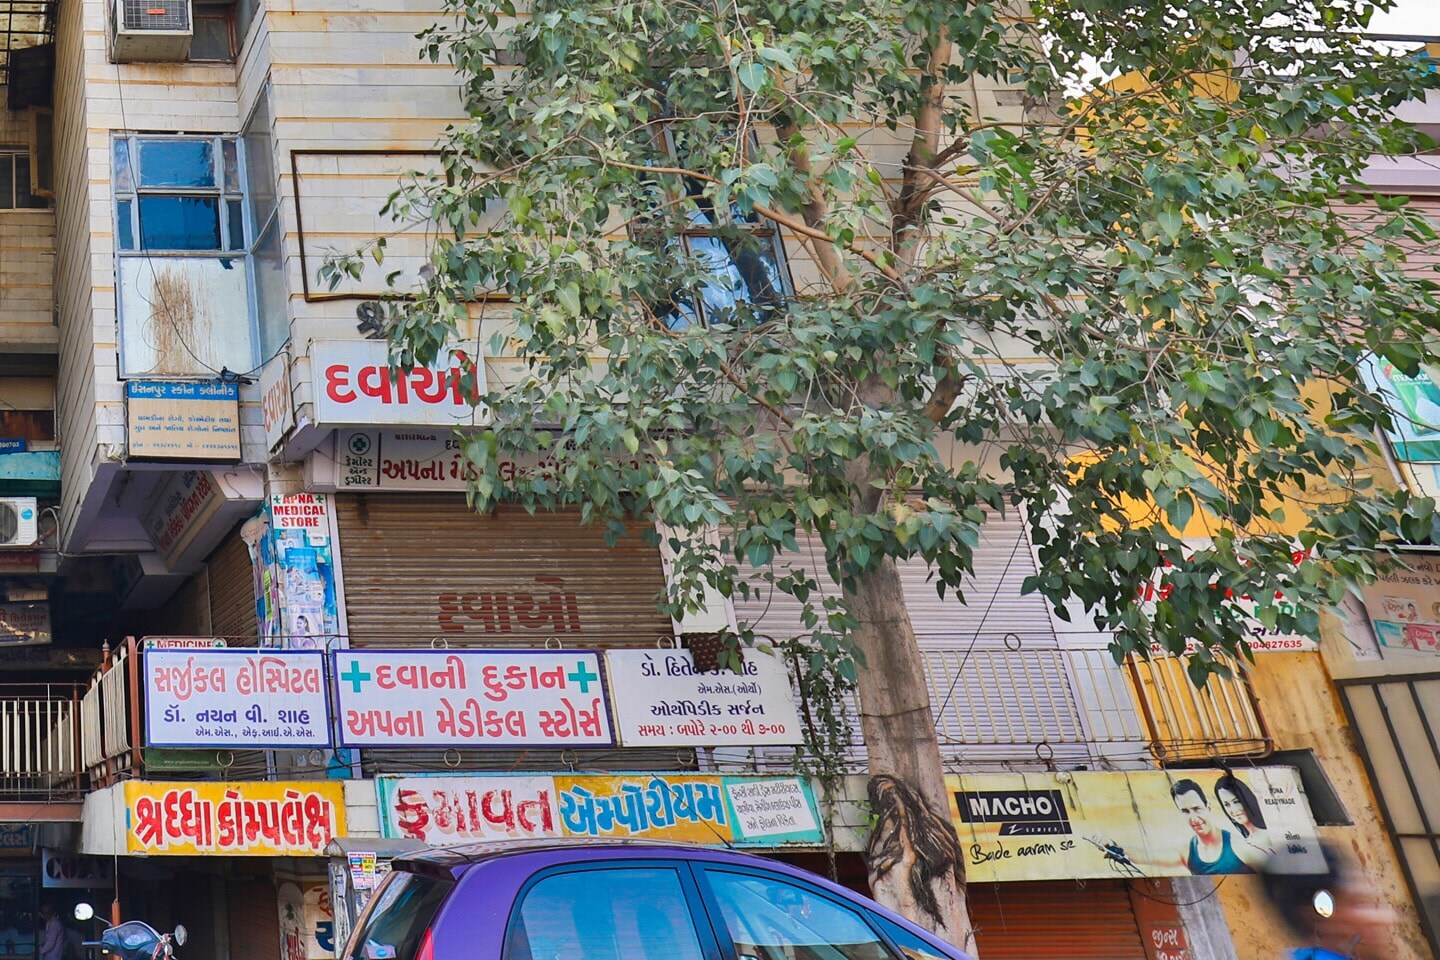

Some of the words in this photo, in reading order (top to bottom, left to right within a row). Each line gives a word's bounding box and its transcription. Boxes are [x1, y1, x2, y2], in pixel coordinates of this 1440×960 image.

[382, 459, 446, 481] અપના
[282, 494, 315, 504] APNA
[274, 505, 325, 515] MEDICAL
[281, 517, 319, 527] STORE
[236, 656, 320, 695] હોસ્પિટલ
[376, 656, 467, 691] દવાની
[482, 665, 566, 702] દુકાન
[196, 709, 237, 723] નયન
[245, 704, 267, 723] વી.
[278, 709, 310, 724] શાહ
[727, 700, 766, 715] સર્જન
[346, 709, 424, 738] અપના
[436, 698, 525, 738] મેડીકલ
[538, 698, 601, 738] સ્ટોર્સ
[638, 725, 666, 737] સમય
[677, 720, 706, 736] બપોરે
[741, 718, 755, 735] થી
[969, 797, 1053, 816] MACHO
[970, 840, 1012, 865] Bade
[1017, 844, 1057, 857] aaram
[1060, 840, 1076, 850] se
